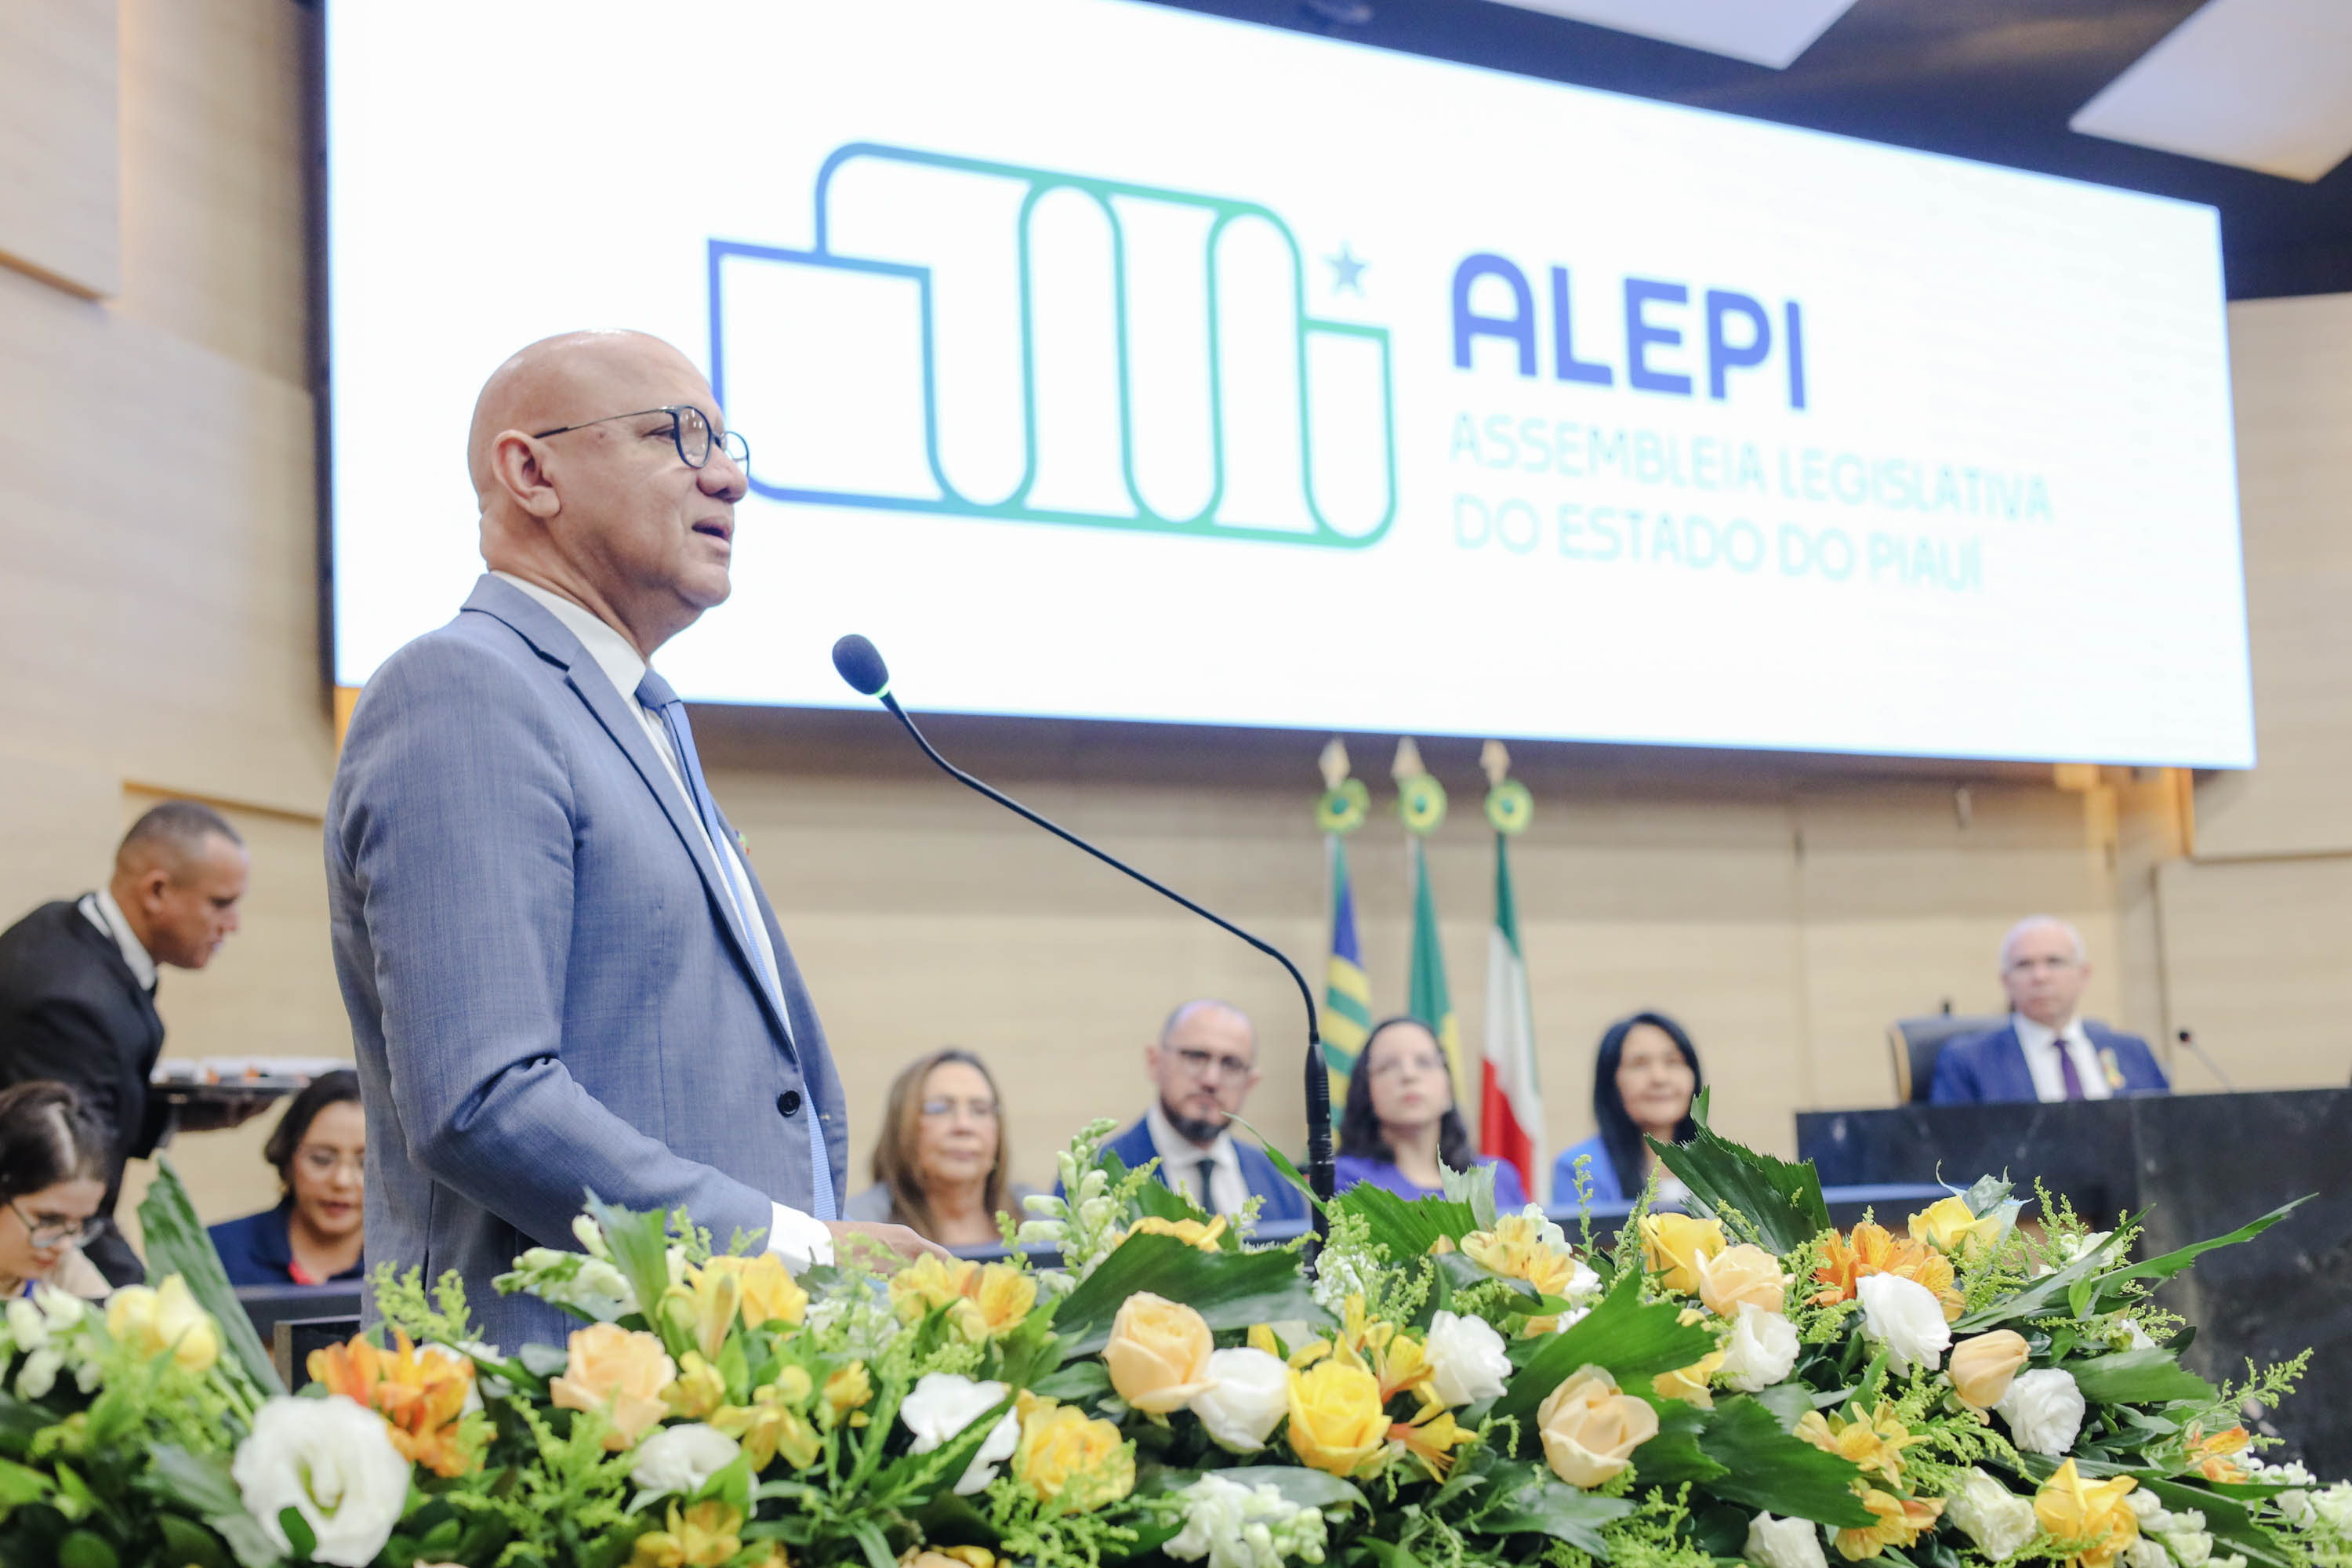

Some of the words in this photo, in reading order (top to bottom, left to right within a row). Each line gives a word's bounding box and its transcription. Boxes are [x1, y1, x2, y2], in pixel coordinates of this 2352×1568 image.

[1451, 251, 1807, 412] ALEPI
[1450, 412, 1767, 492] ASSEMBLEIA
[1779, 447, 2053, 521] LEGISLATIVA
[1454, 493, 1541, 554] DO
[1558, 503, 1766, 573] ESTADO
[1778, 523, 1855, 581] DO
